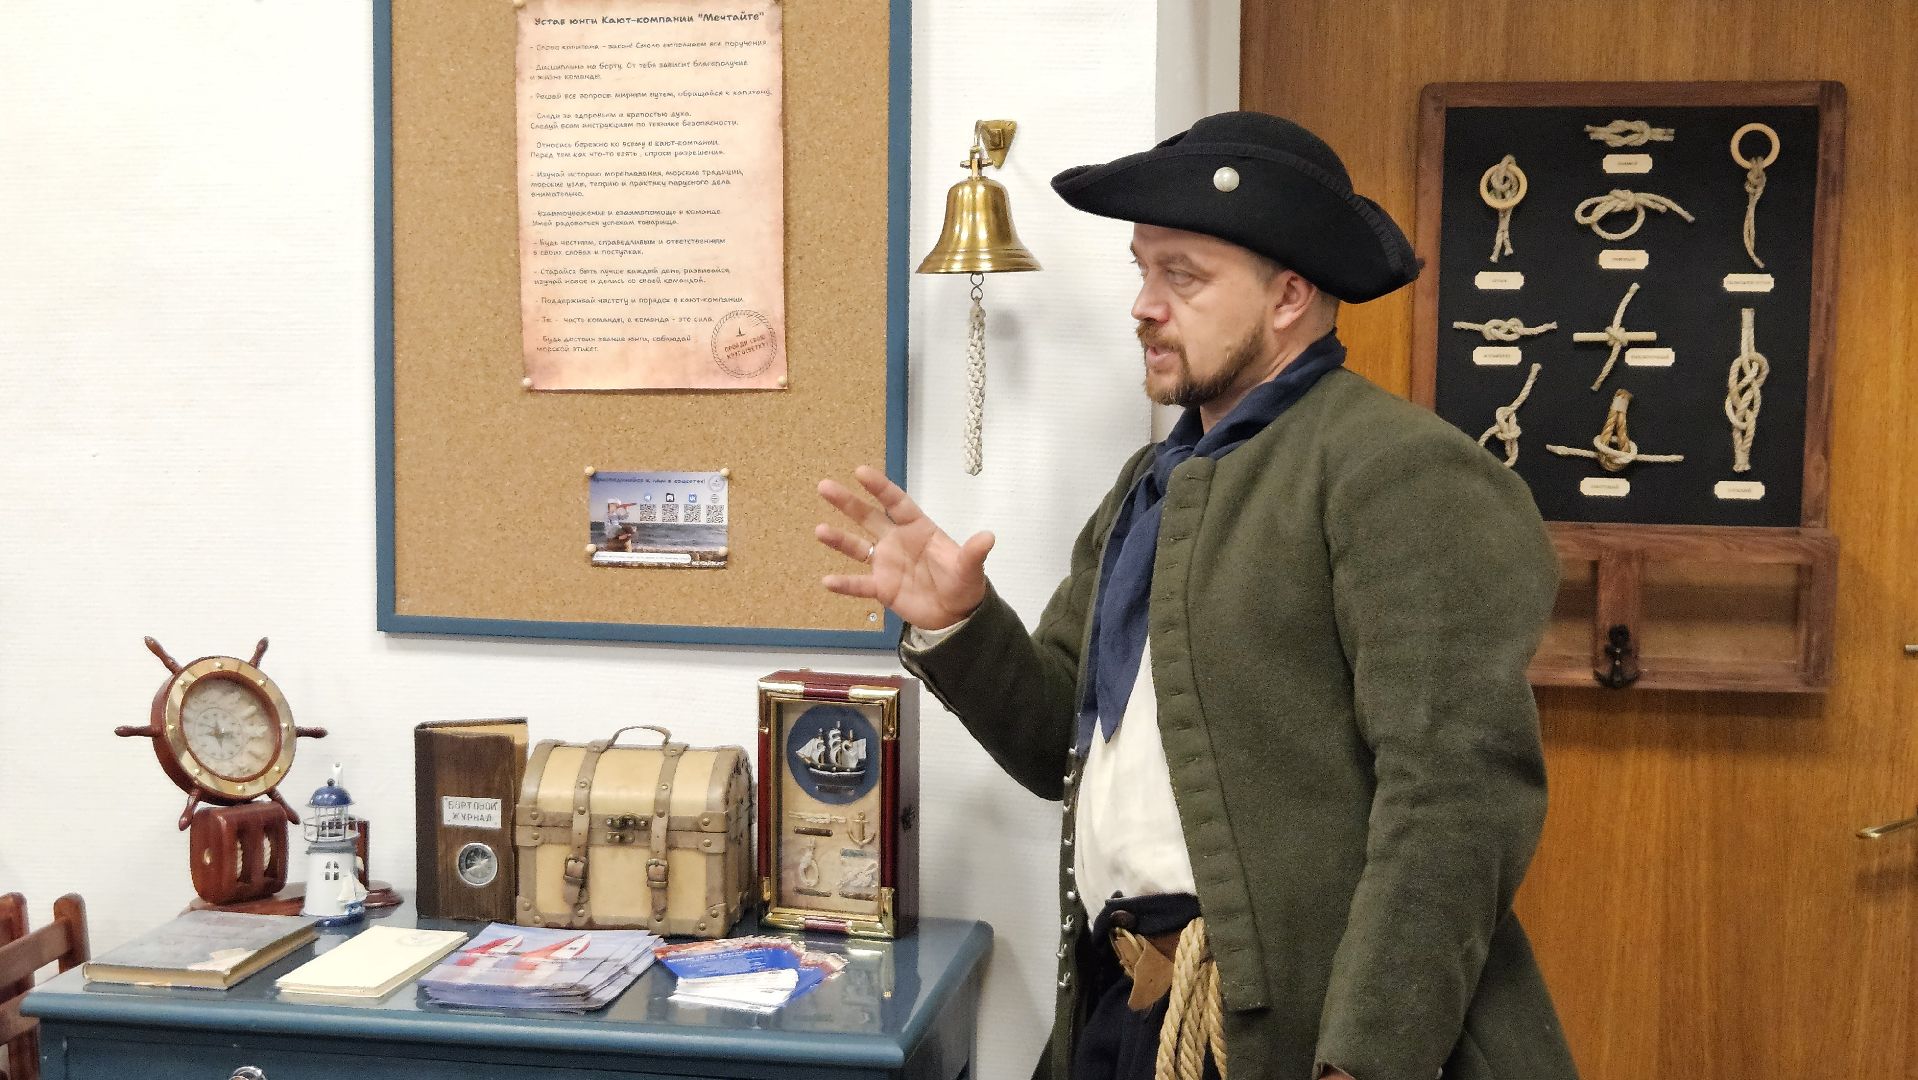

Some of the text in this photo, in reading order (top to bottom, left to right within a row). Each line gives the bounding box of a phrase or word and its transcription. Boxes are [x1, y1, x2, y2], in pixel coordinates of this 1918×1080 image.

[534, 18, 565, 26] Устав
[602, 16, 694, 24] Кают-компании
[698, 11, 764, 21] "Мечтайте"
[574, 141, 608, 149] бережно
[452, 812, 492, 822] ЖУРНАЛ
